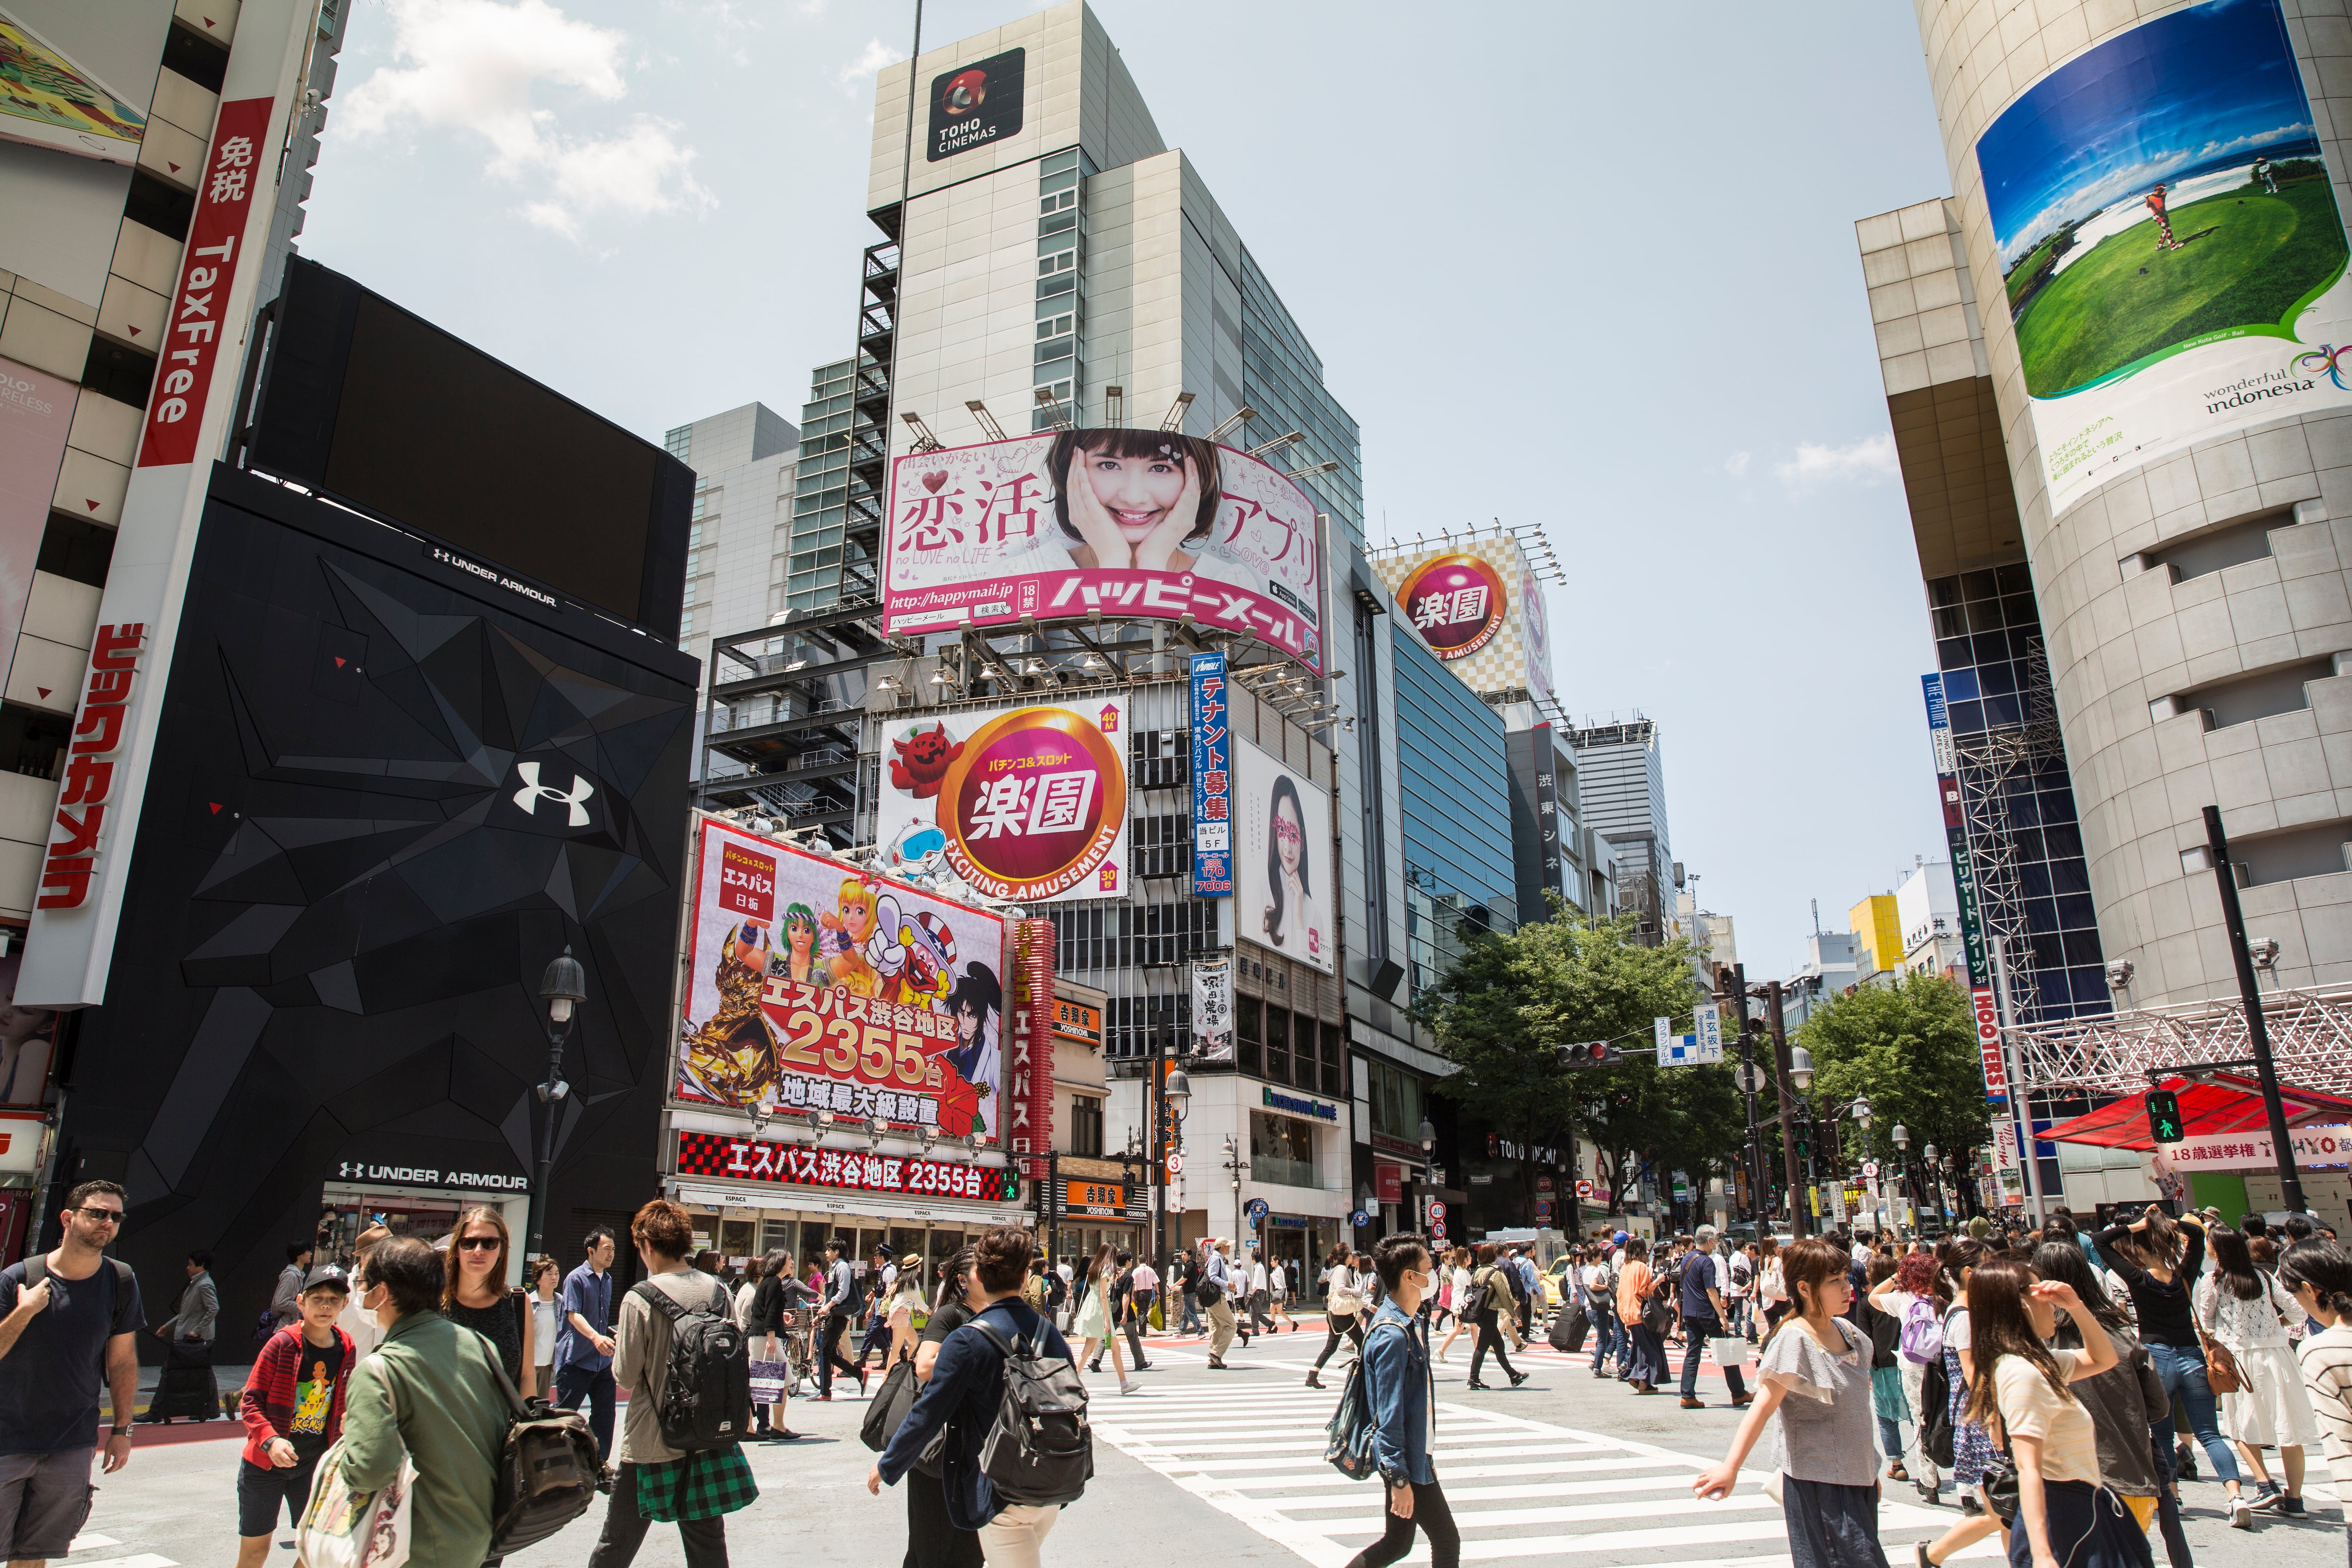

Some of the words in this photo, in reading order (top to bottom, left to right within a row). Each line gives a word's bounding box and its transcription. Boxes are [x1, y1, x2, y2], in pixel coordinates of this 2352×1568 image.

[938, 126, 996, 152] CINEMAS
[940, 118, 980, 141] TOHO
[210, 136, 253, 203] 免税
[158, 236, 234, 423] TaxFree
[2198, 336, 2212, 345] Kuta
[2202, 369, 2288, 399] wonderful
[2205, 379, 2315, 414] indonesia
[2049, 416, 2114, 463] ようこそインドネシアへ
[903, 450, 986, 470] 出会いがない
[2051, 439, 2089, 471] くつろぎの中で
[2052, 431, 2123, 482] 美に囲まれるという贅沢
[898, 472, 1042, 551] 恋活
[1221, 491, 1314, 586] アプリ
[452, 556, 498, 583] UNDER
[913, 549, 945, 565] LOVE
[946, 552, 959, 564] no
[962, 547, 992, 564] LIFE
[1230, 536, 1269, 575] Love
[890, 583, 1013, 609] http://happymail.jp
[1023, 585, 1035, 596] 18
[1023, 597, 1034, 608] 禁
[893, 613, 944, 625] ハッピーメール
[981, 605, 999, 614] 検索
[1049, 571, 1297, 649] ハッピーメール
[1414, 585, 1488, 630] 楽園
[1446, 614, 1502, 660] AMUSEMENT
[1926, 680, 1942, 697] THE
[1102, 712, 1116, 723] 40
[1929, 698, 1947, 726] PRIME
[1194, 726, 1202, 769] 東急リバブル
[1202, 677, 1230, 821] テナント募集
[37, 622, 151, 910] ビックカメラ
[989, 753, 1072, 772] パチンコ&スロット
[966, 770, 1097, 841] 楽園
[1199, 826, 1226, 835] 当ビル
[725, 851, 774, 873] パチンコ&スロット
[945, 838, 1009, 898] EXCITING
[1017, 824, 1116, 900] AMUSEMENT
[1101, 870, 1115, 881] 30
[1201, 867, 1225, 877] 170
[723, 867, 773, 896] エスパス
[1196, 880, 1231, 891] 7006
[736, 893, 758, 911] 日拓
[1955, 851, 1986, 973] ビリヤード・ダーツ
[1016, 920, 1033, 1002] パチンコ
[1976, 976, 1987, 984] 3F
[761, 977, 958, 1043] エスパス渋谷地区
[1060, 1004, 1089, 1027] 吉野家
[1060, 1024, 1089, 1038] YOSHINOYA
[1659, 1019, 1669, 1065] スクランブル式
[1705, 1010, 1718, 1058] 道玄坂下
[1974, 993, 2005, 1089] HOOTERS
[781, 1014, 944, 1089] 2355台
[781, 1076, 940, 1126] 地域最大級設置
[1263, 1087, 1311, 1115] EXCELSIOR
[1999, 1131, 2009, 1168] Miami
[2006, 1123, 2015, 1147] Villa
[2171, 1143, 2256, 1161] 18歳選挙権
[369, 1165, 439, 1183] UNDER
[445, 1171, 527, 1189] ARMOUR
[728, 1142, 902, 1188] エスパス渋谷地区
[909, 1162, 981, 1196] 2355台
[1171, 1158, 1179, 1169] 3
[1866, 1165, 1873, 1174] 4
[1086, 1185, 1116, 1204] 吉野家
[1087, 1206, 1114, 1216] YOSHINOYA
[322, 1266, 341, 1277] 侍
